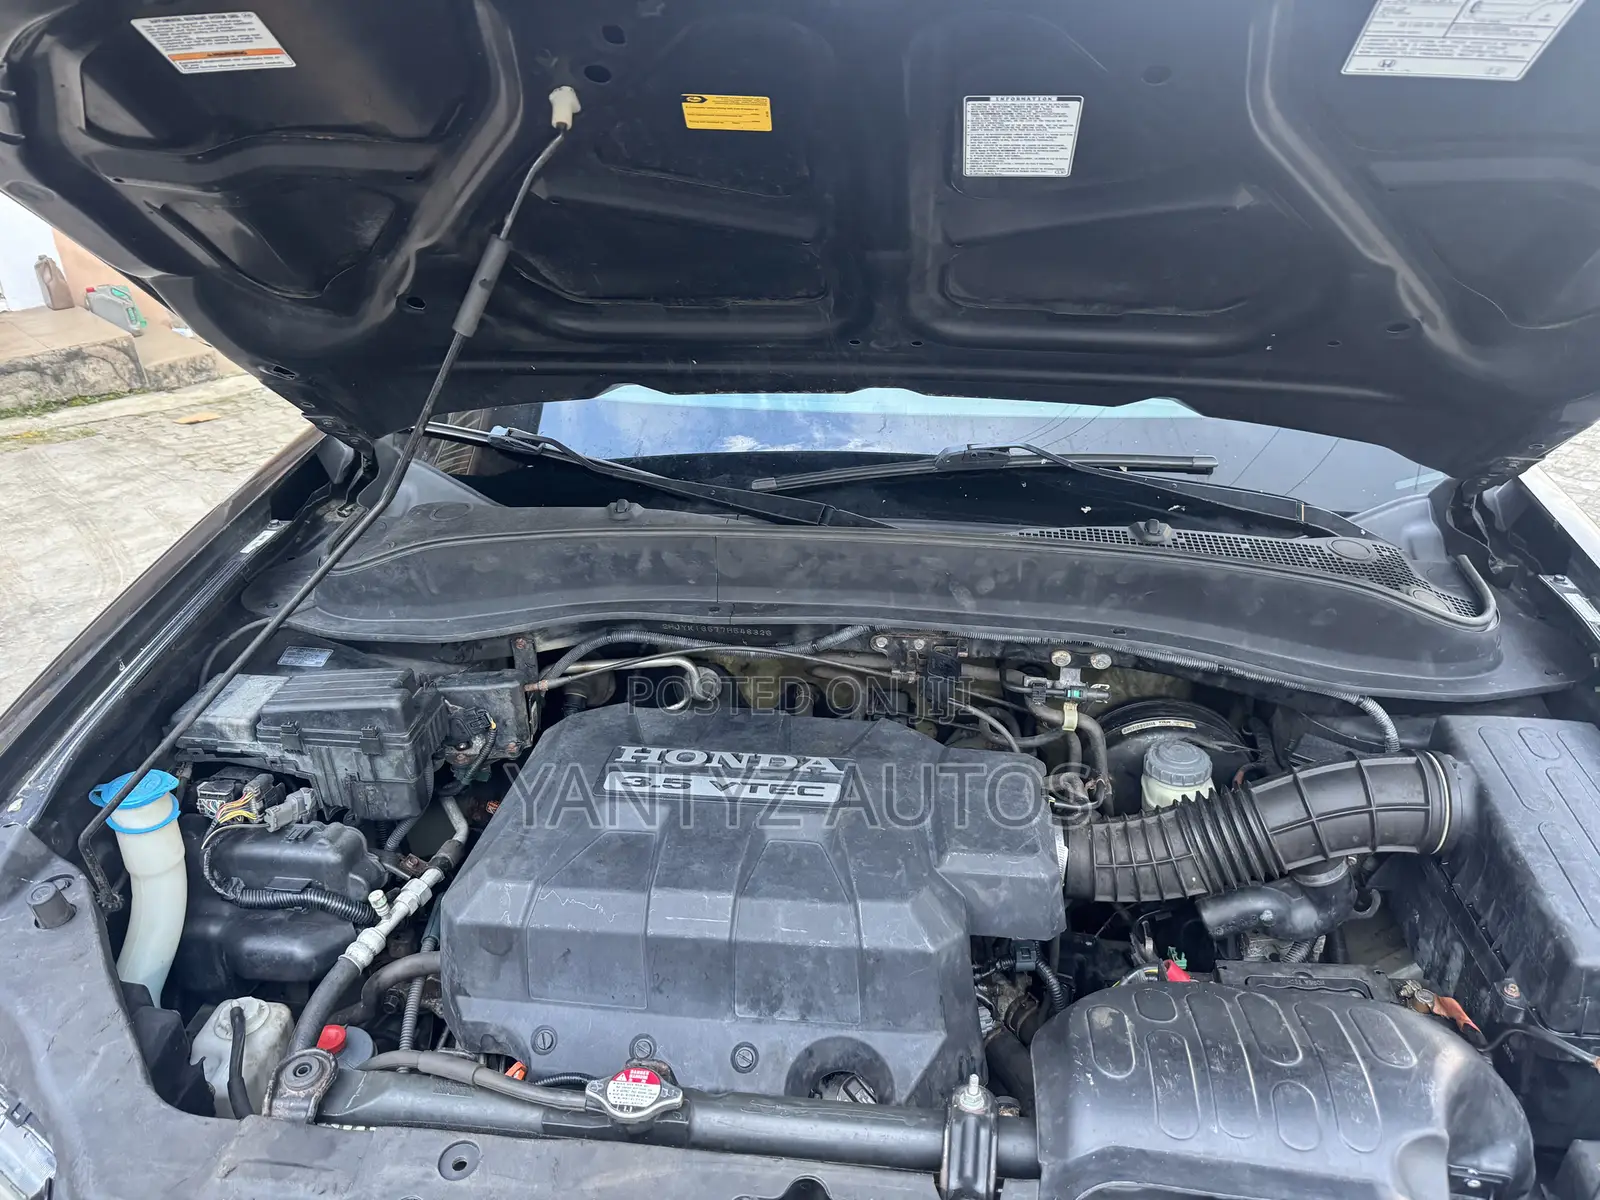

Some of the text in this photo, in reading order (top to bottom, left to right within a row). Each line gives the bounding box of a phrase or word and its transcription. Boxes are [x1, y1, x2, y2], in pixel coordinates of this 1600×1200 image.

[614, 746, 846, 776] HONDA
[620, 775, 827, 798] 3.5 VTEC
